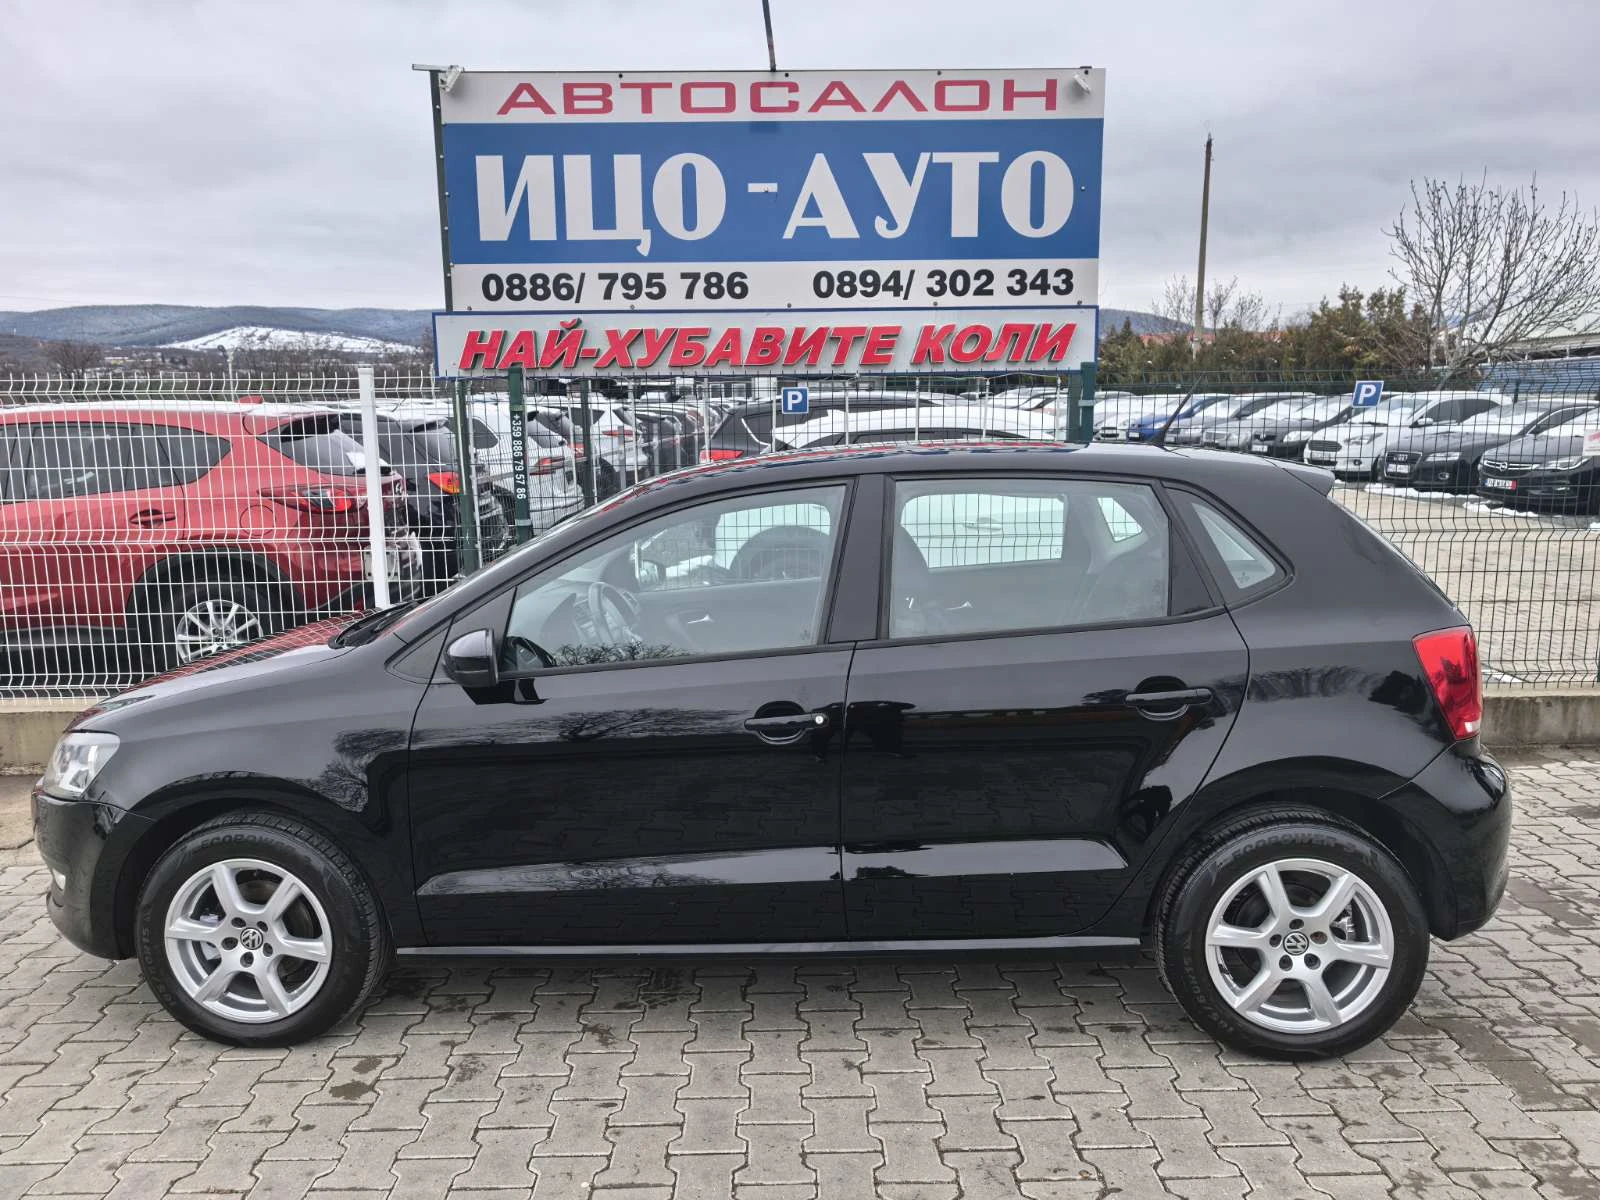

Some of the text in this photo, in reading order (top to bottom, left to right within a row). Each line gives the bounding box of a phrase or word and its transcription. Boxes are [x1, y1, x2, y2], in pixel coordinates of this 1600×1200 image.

[496, 78, 1058, 116] АВТОСАЛОН
[481, 271, 749, 304] 0886/ 795 786
[812, 267, 1074, 301] 0894/ 302 343
[458, 317, 1077, 370] НАЙ-ХУБАВИТЕ КОЛИ
[787, 390, 803, 411] P
[1358, 384, 1377, 405] P
[512, 413, 527, 500] +359 886 79 57 86
